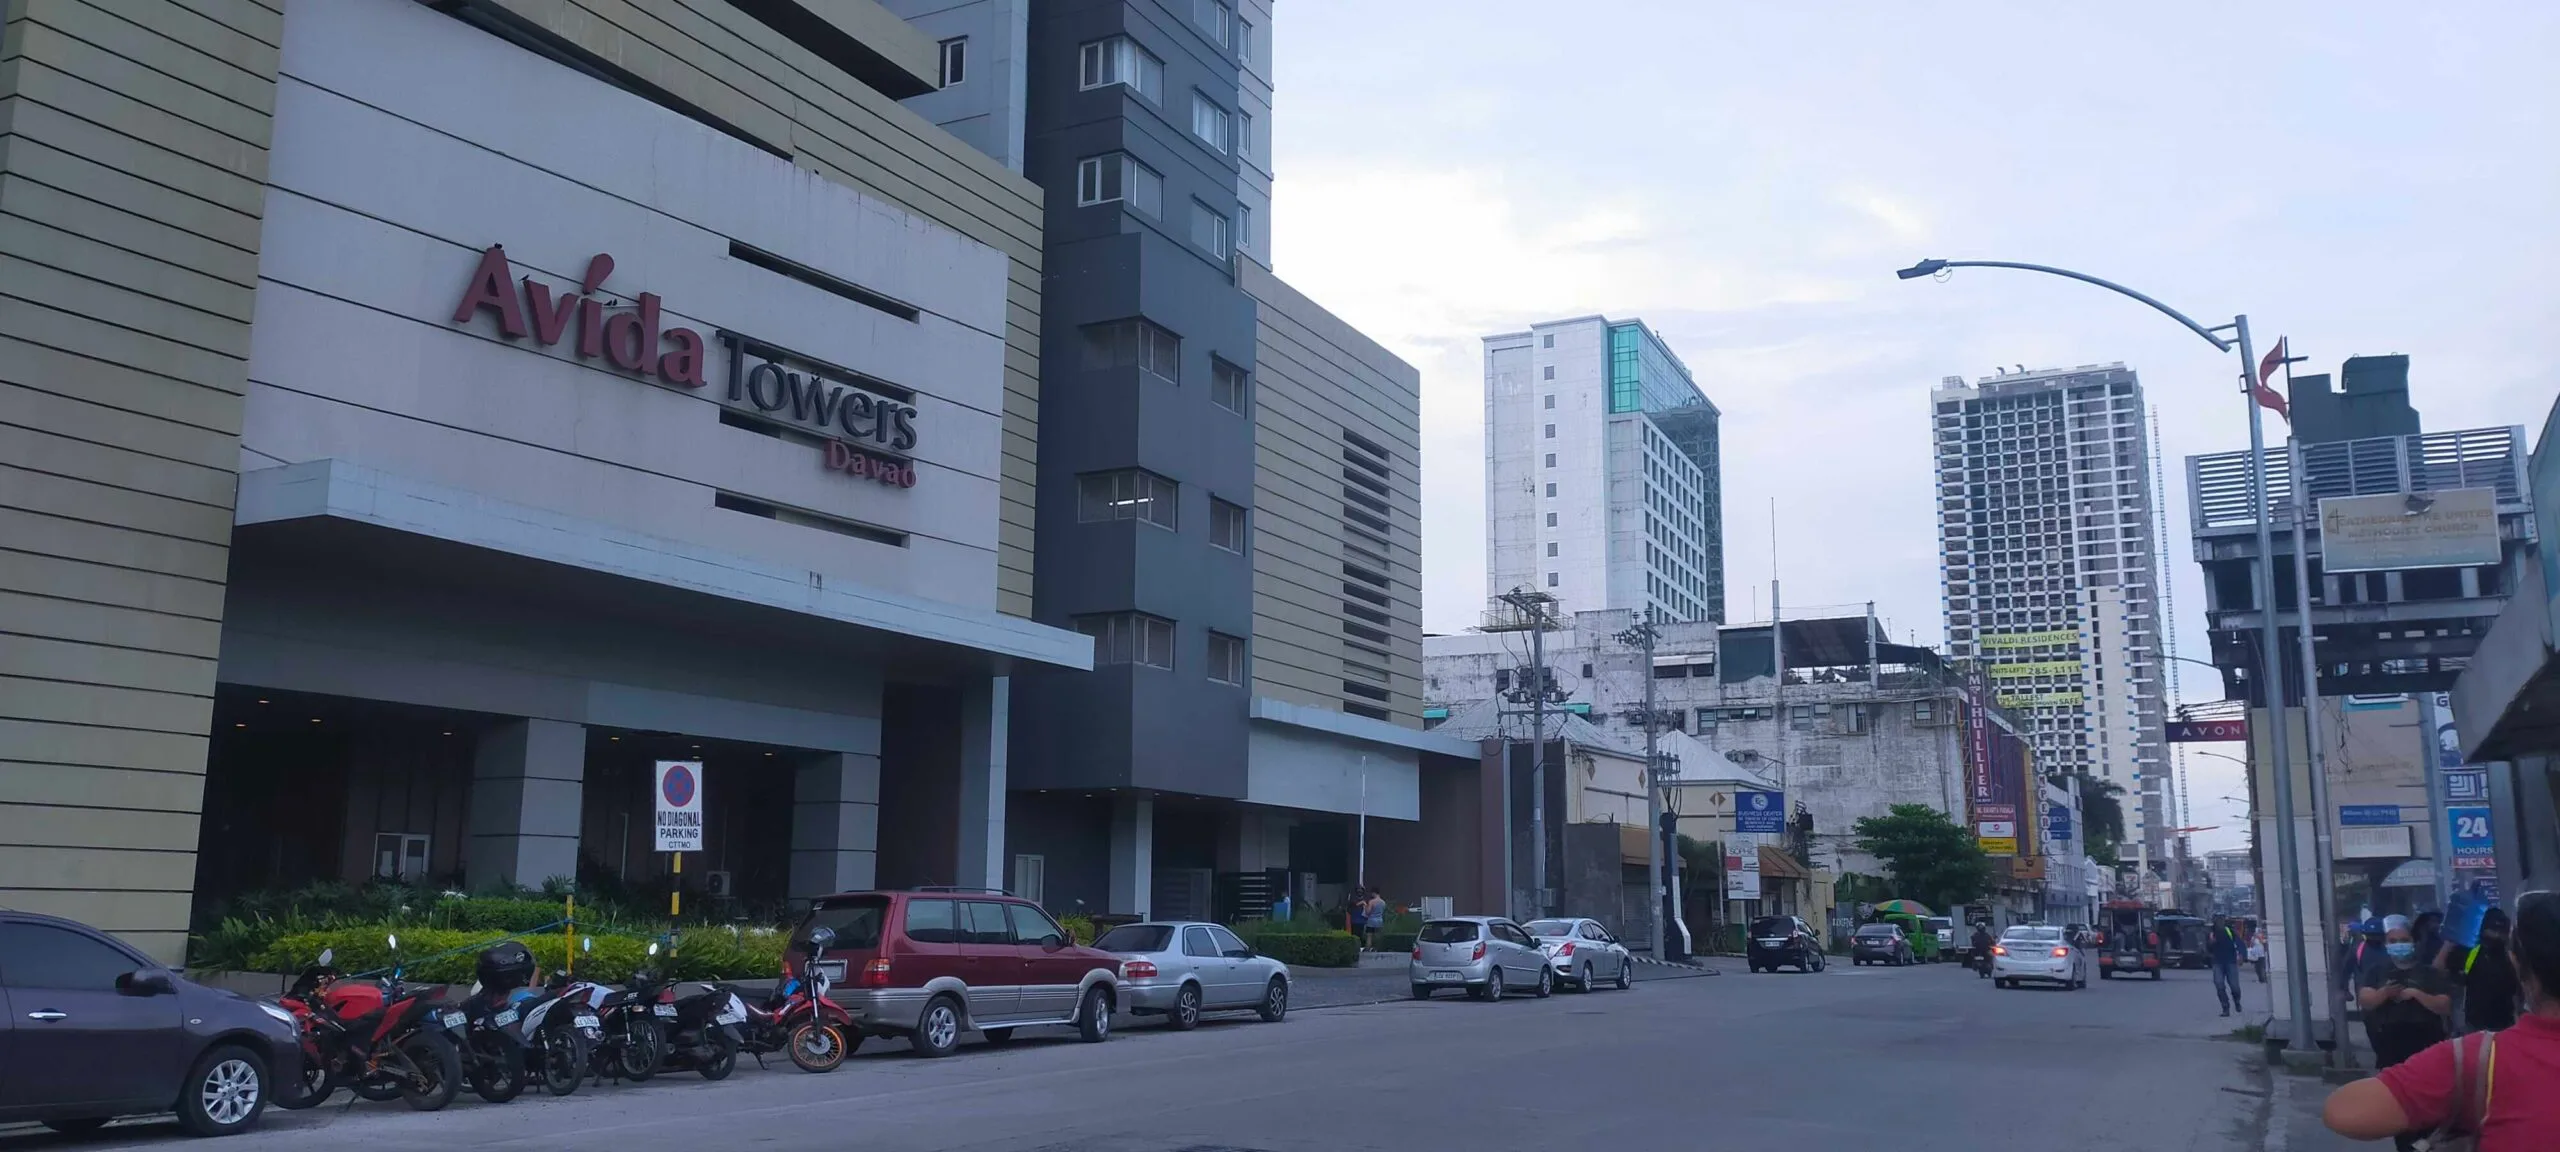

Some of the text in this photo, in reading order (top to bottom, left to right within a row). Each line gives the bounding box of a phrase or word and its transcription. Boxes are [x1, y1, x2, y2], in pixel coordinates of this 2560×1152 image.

[452, 246, 918, 451] Avida Towers
[824, 437, 918, 488] Davao
[2348, 527, 2420, 538] METHODIST
[2425, 523, 2479, 533] CHURCH
[1983, 633, 2077, 645] VIVALDI RESIDENCES
[2028, 665, 2080, 675] 285-1111
[2011, 694, 2043, 702] TALLEST
[2182, 726, 2240, 736] AVON
[1972, 696, 1989, 797] LHUILLIER
[657, 811, 700, 826] NO DIAGONAL
[2458, 816, 2488, 838] 24
[660, 828, 699, 839] PARKING
[669, 841, 691, 849] CTTMO
[2457, 847, 2494, 855] HOURS
[2458, 857, 2488, 865] PICK
